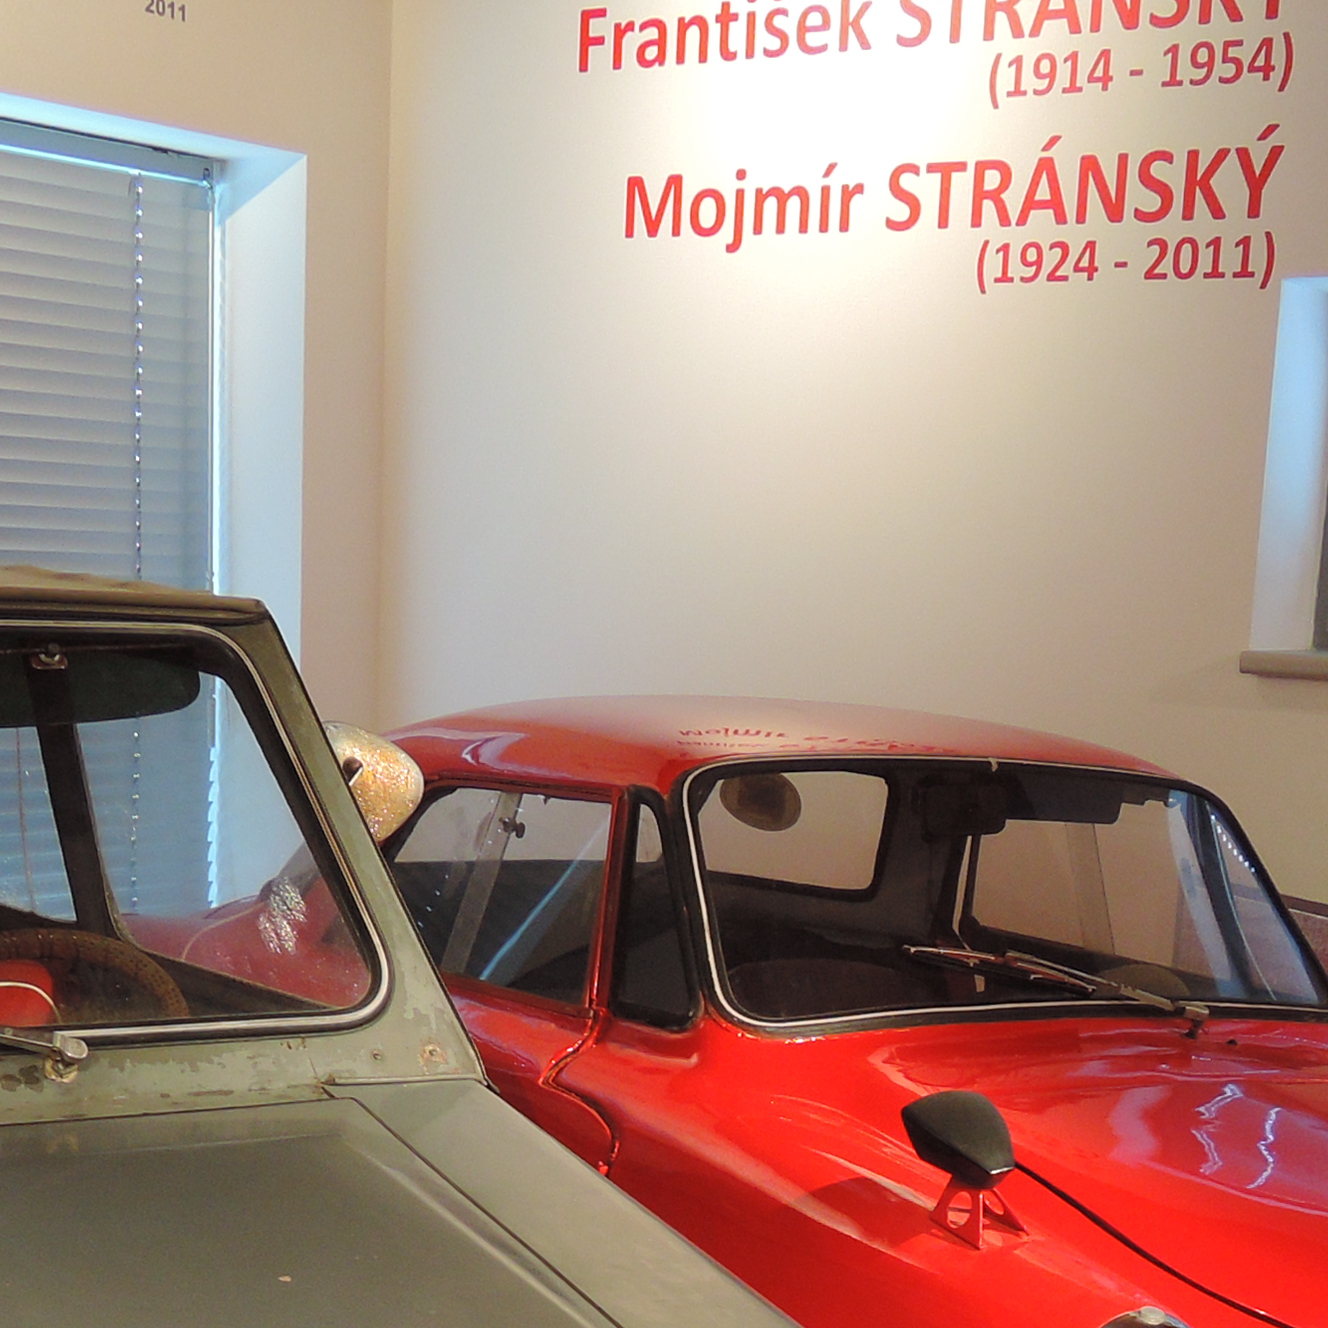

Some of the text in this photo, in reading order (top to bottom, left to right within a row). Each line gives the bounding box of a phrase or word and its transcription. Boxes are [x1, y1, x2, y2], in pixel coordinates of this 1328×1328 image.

[145, 0, 186, 22] 2011
[989, 48, 1113, 110] (1914
[1161, 31, 1293, 93] 1954)
[625, 123, 1285, 253] Mojmír STRÁNSKÝ
[976, 239, 1099, 294] (1924
[1143, 231, 1276, 290] 2011)
